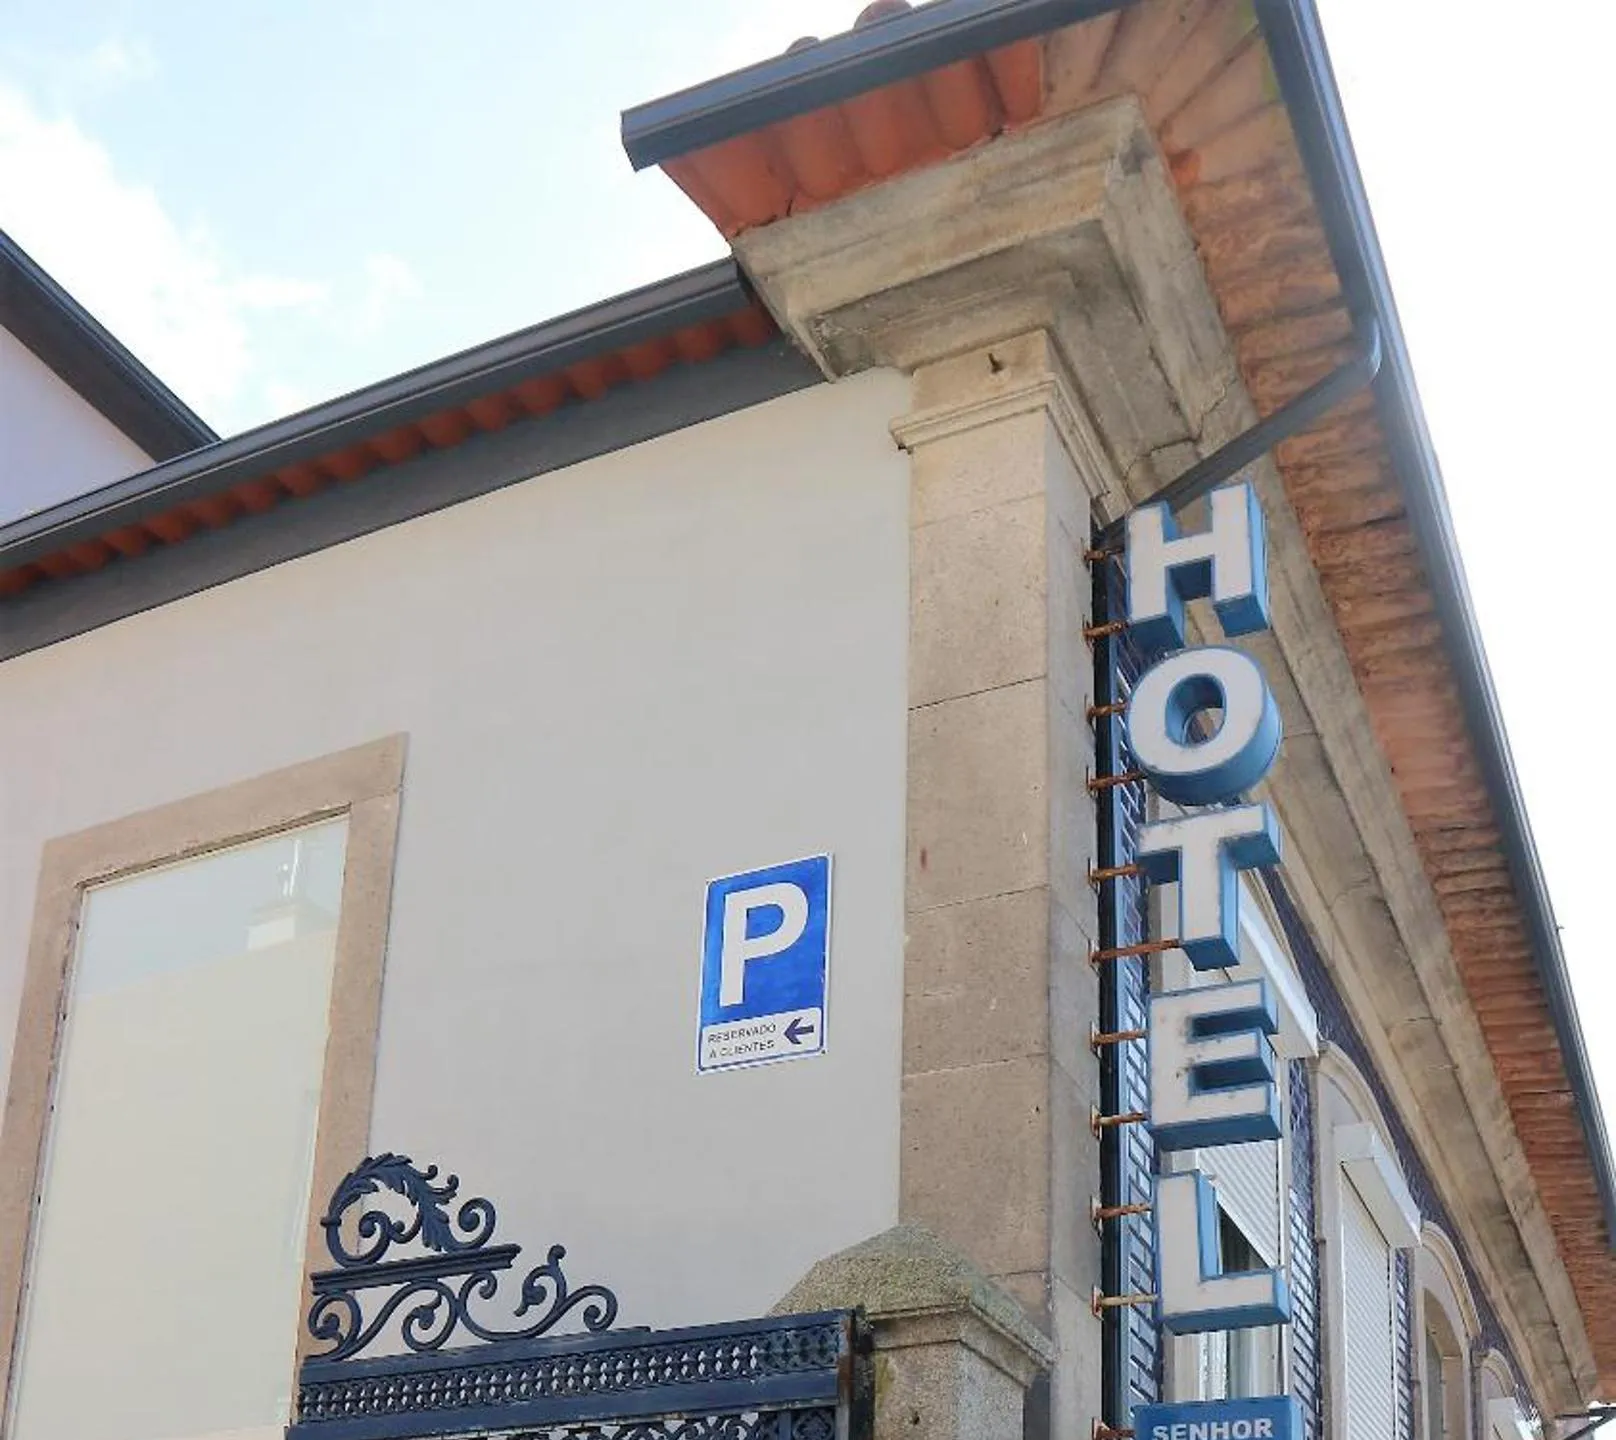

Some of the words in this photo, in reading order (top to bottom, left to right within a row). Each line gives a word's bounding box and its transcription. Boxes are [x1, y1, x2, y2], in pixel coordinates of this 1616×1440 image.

[1126, 482, 1284, 1328] HOTEL
[719, 881, 809, 1008] P
[707, 1022, 777, 1043] RESERVADO
[709, 1048, 717, 1059] A
[719, 1039, 775, 1057] CLIENTES
